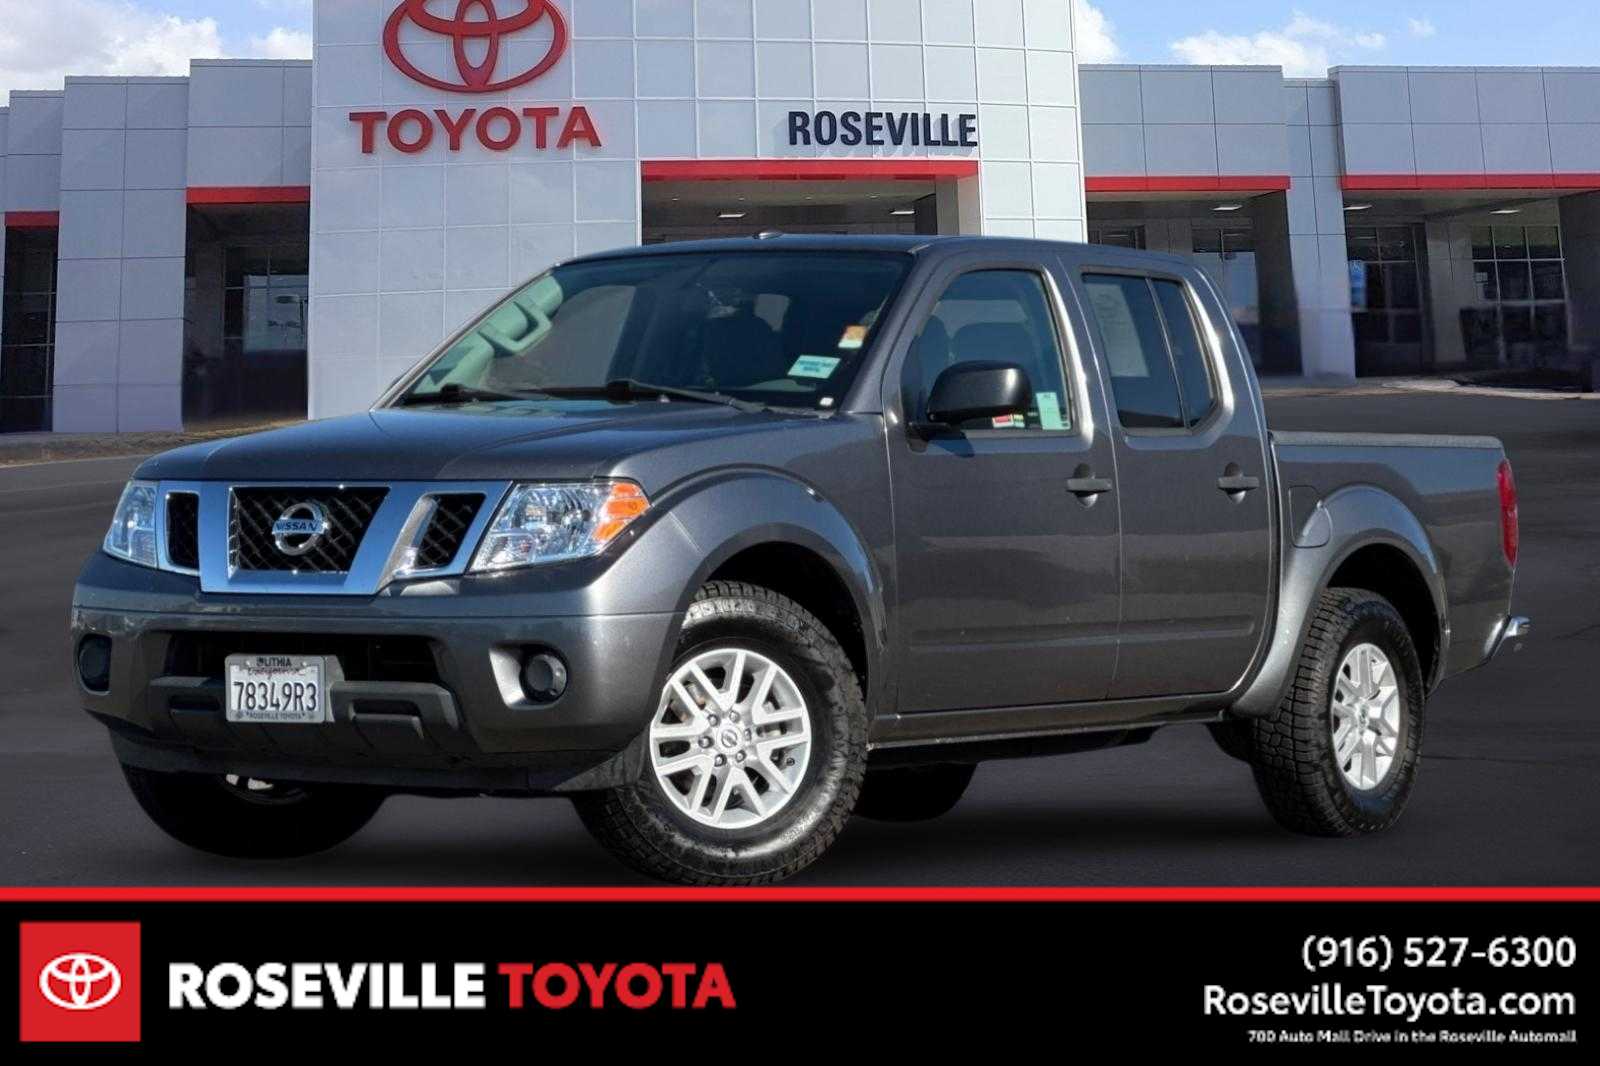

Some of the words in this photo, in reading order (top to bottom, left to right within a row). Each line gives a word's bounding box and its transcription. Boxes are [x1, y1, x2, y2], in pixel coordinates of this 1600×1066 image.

[349, 106, 603, 154] TOYOTA
[788, 110, 978, 147] ROSEVILLE
[276, 521, 318, 531] NISSAN
[233, 681, 317, 711] 78349R3
